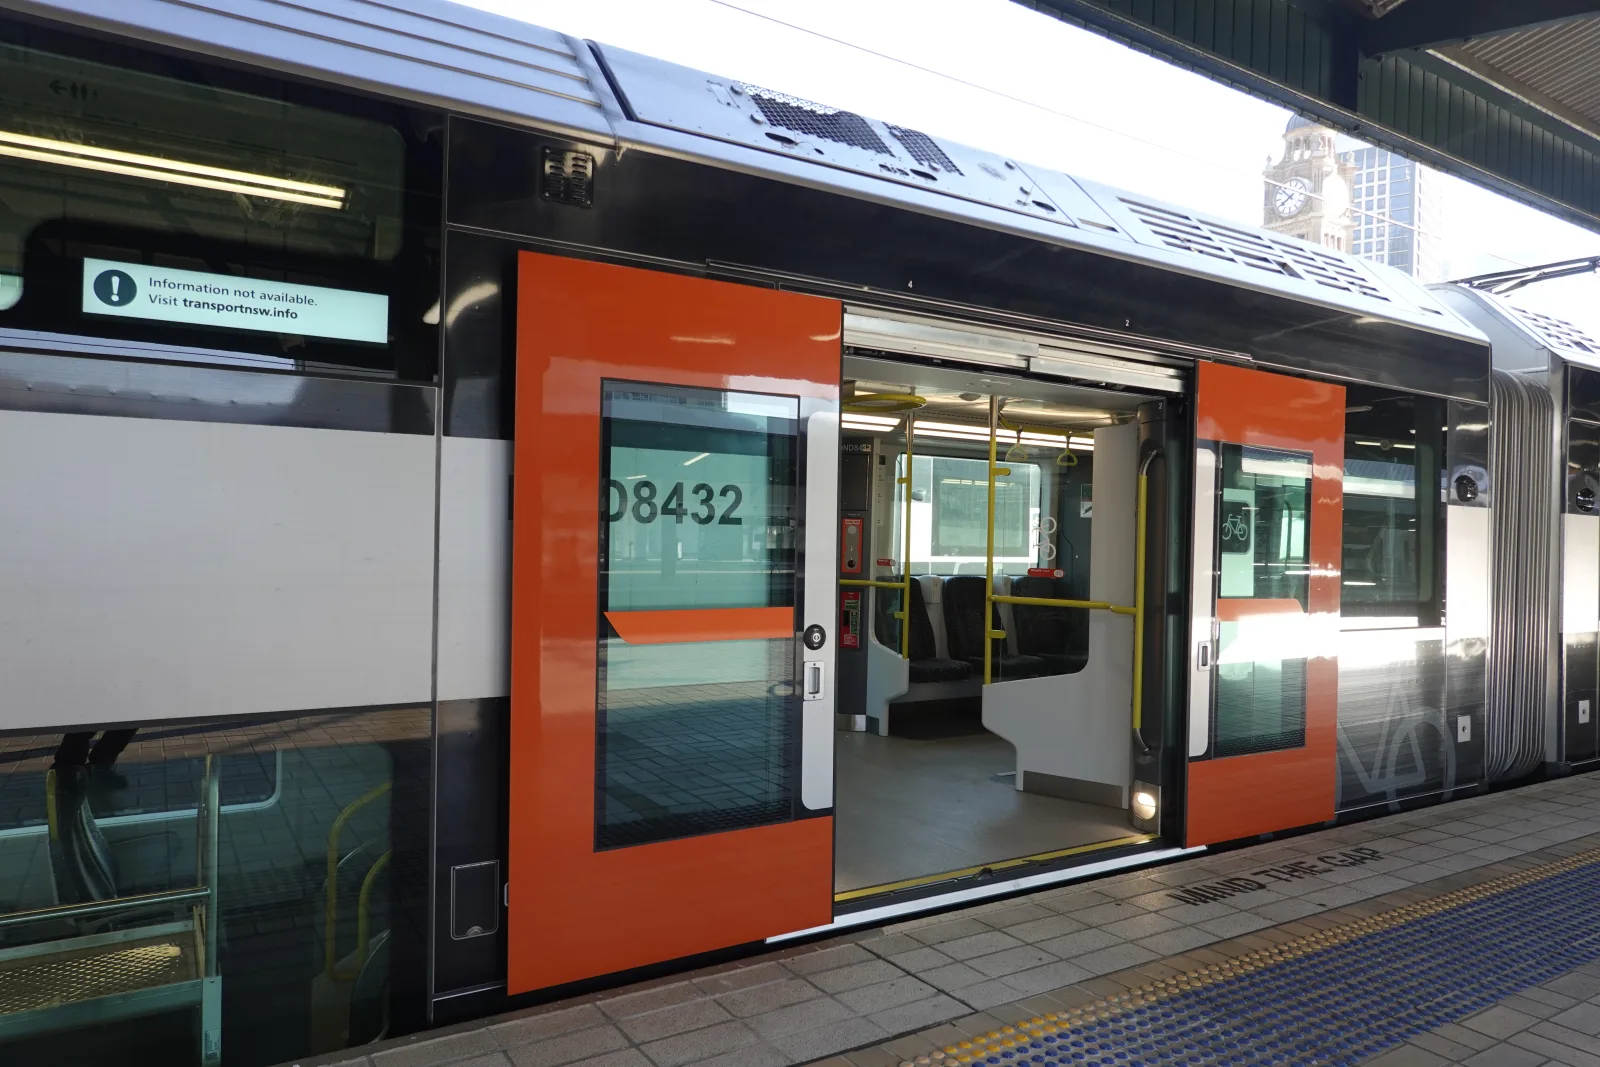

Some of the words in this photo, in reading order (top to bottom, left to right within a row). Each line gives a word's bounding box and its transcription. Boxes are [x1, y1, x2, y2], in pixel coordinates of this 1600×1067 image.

[149, 277, 229, 296] Information
[234, 288, 256, 299] not
[259, 292, 318, 306] available.
[907, 280, 913, 289] 4
[149, 294, 179, 307] Visit
[182, 297, 298, 319] transportnsw.info
[1125, 319, 1130, 327] 2
[1158, 402, 1163, 410] 2
[1166, 876, 1267, 906] MIND
[1251, 861, 1335, 882] THE
[1317, 847, 1386, 868] GAP
